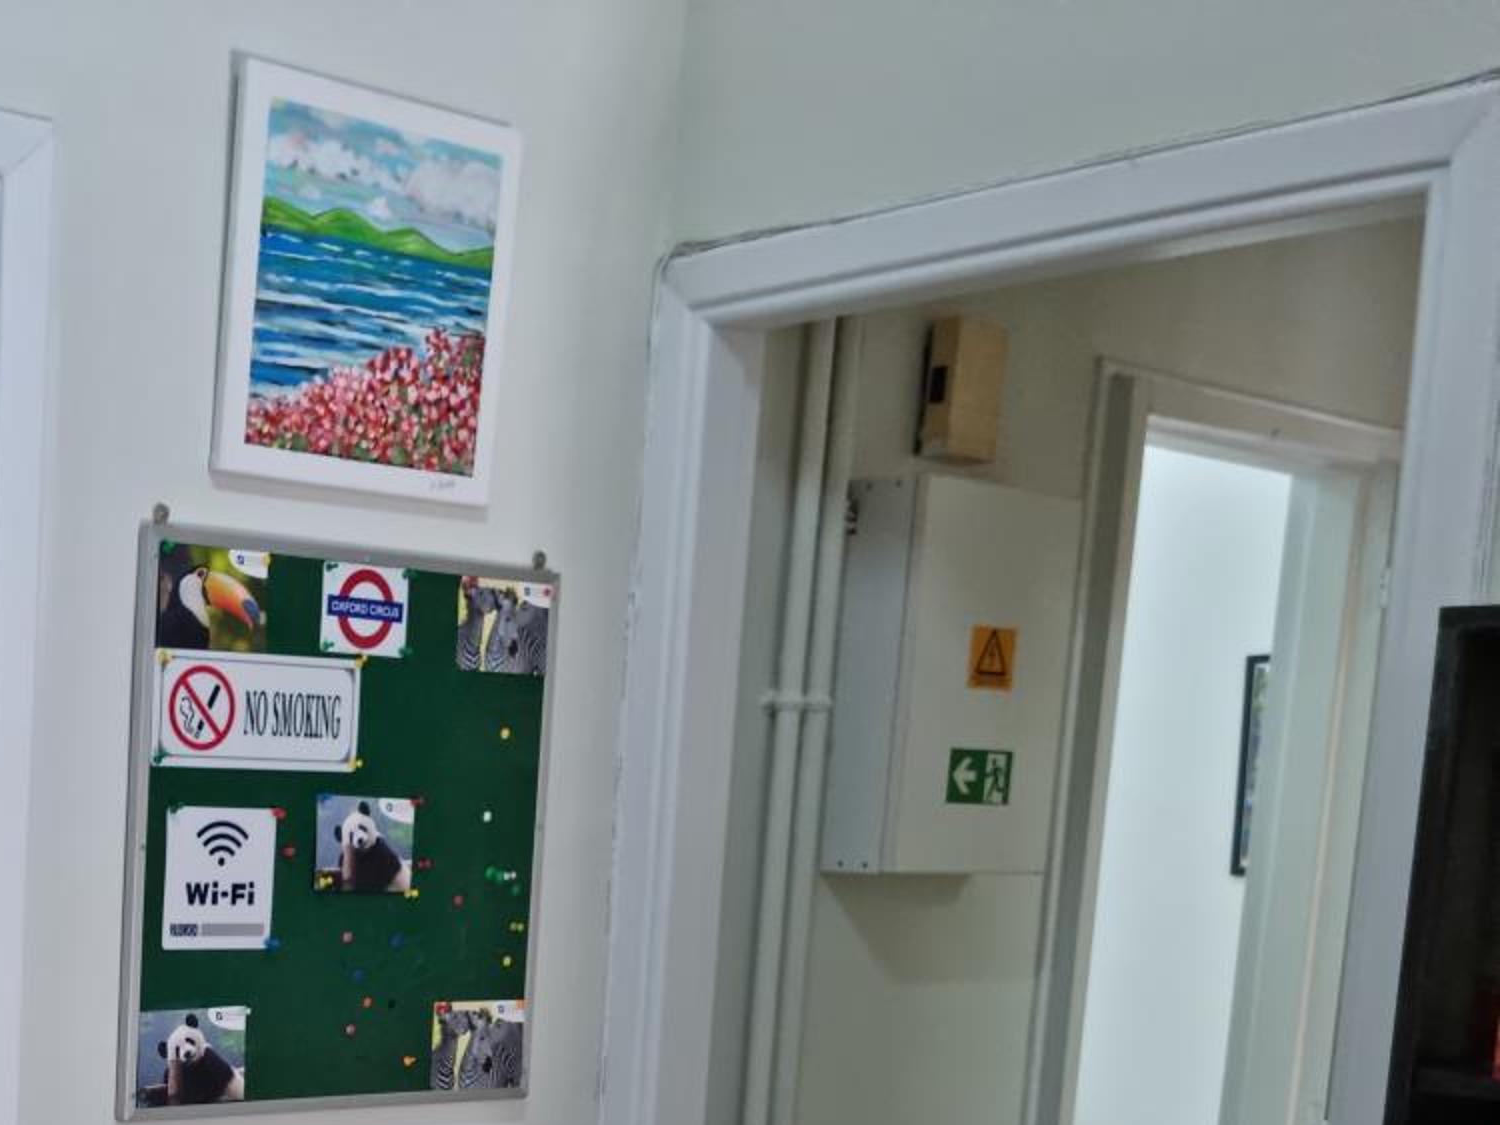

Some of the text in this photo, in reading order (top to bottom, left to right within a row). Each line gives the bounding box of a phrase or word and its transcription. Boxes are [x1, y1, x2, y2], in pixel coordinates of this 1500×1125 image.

[331, 600, 399, 618] OXFORD CIRCUS
[243, 690, 341, 739] NO SMOKING
[185, 880, 255, 906] Wi-Fi
